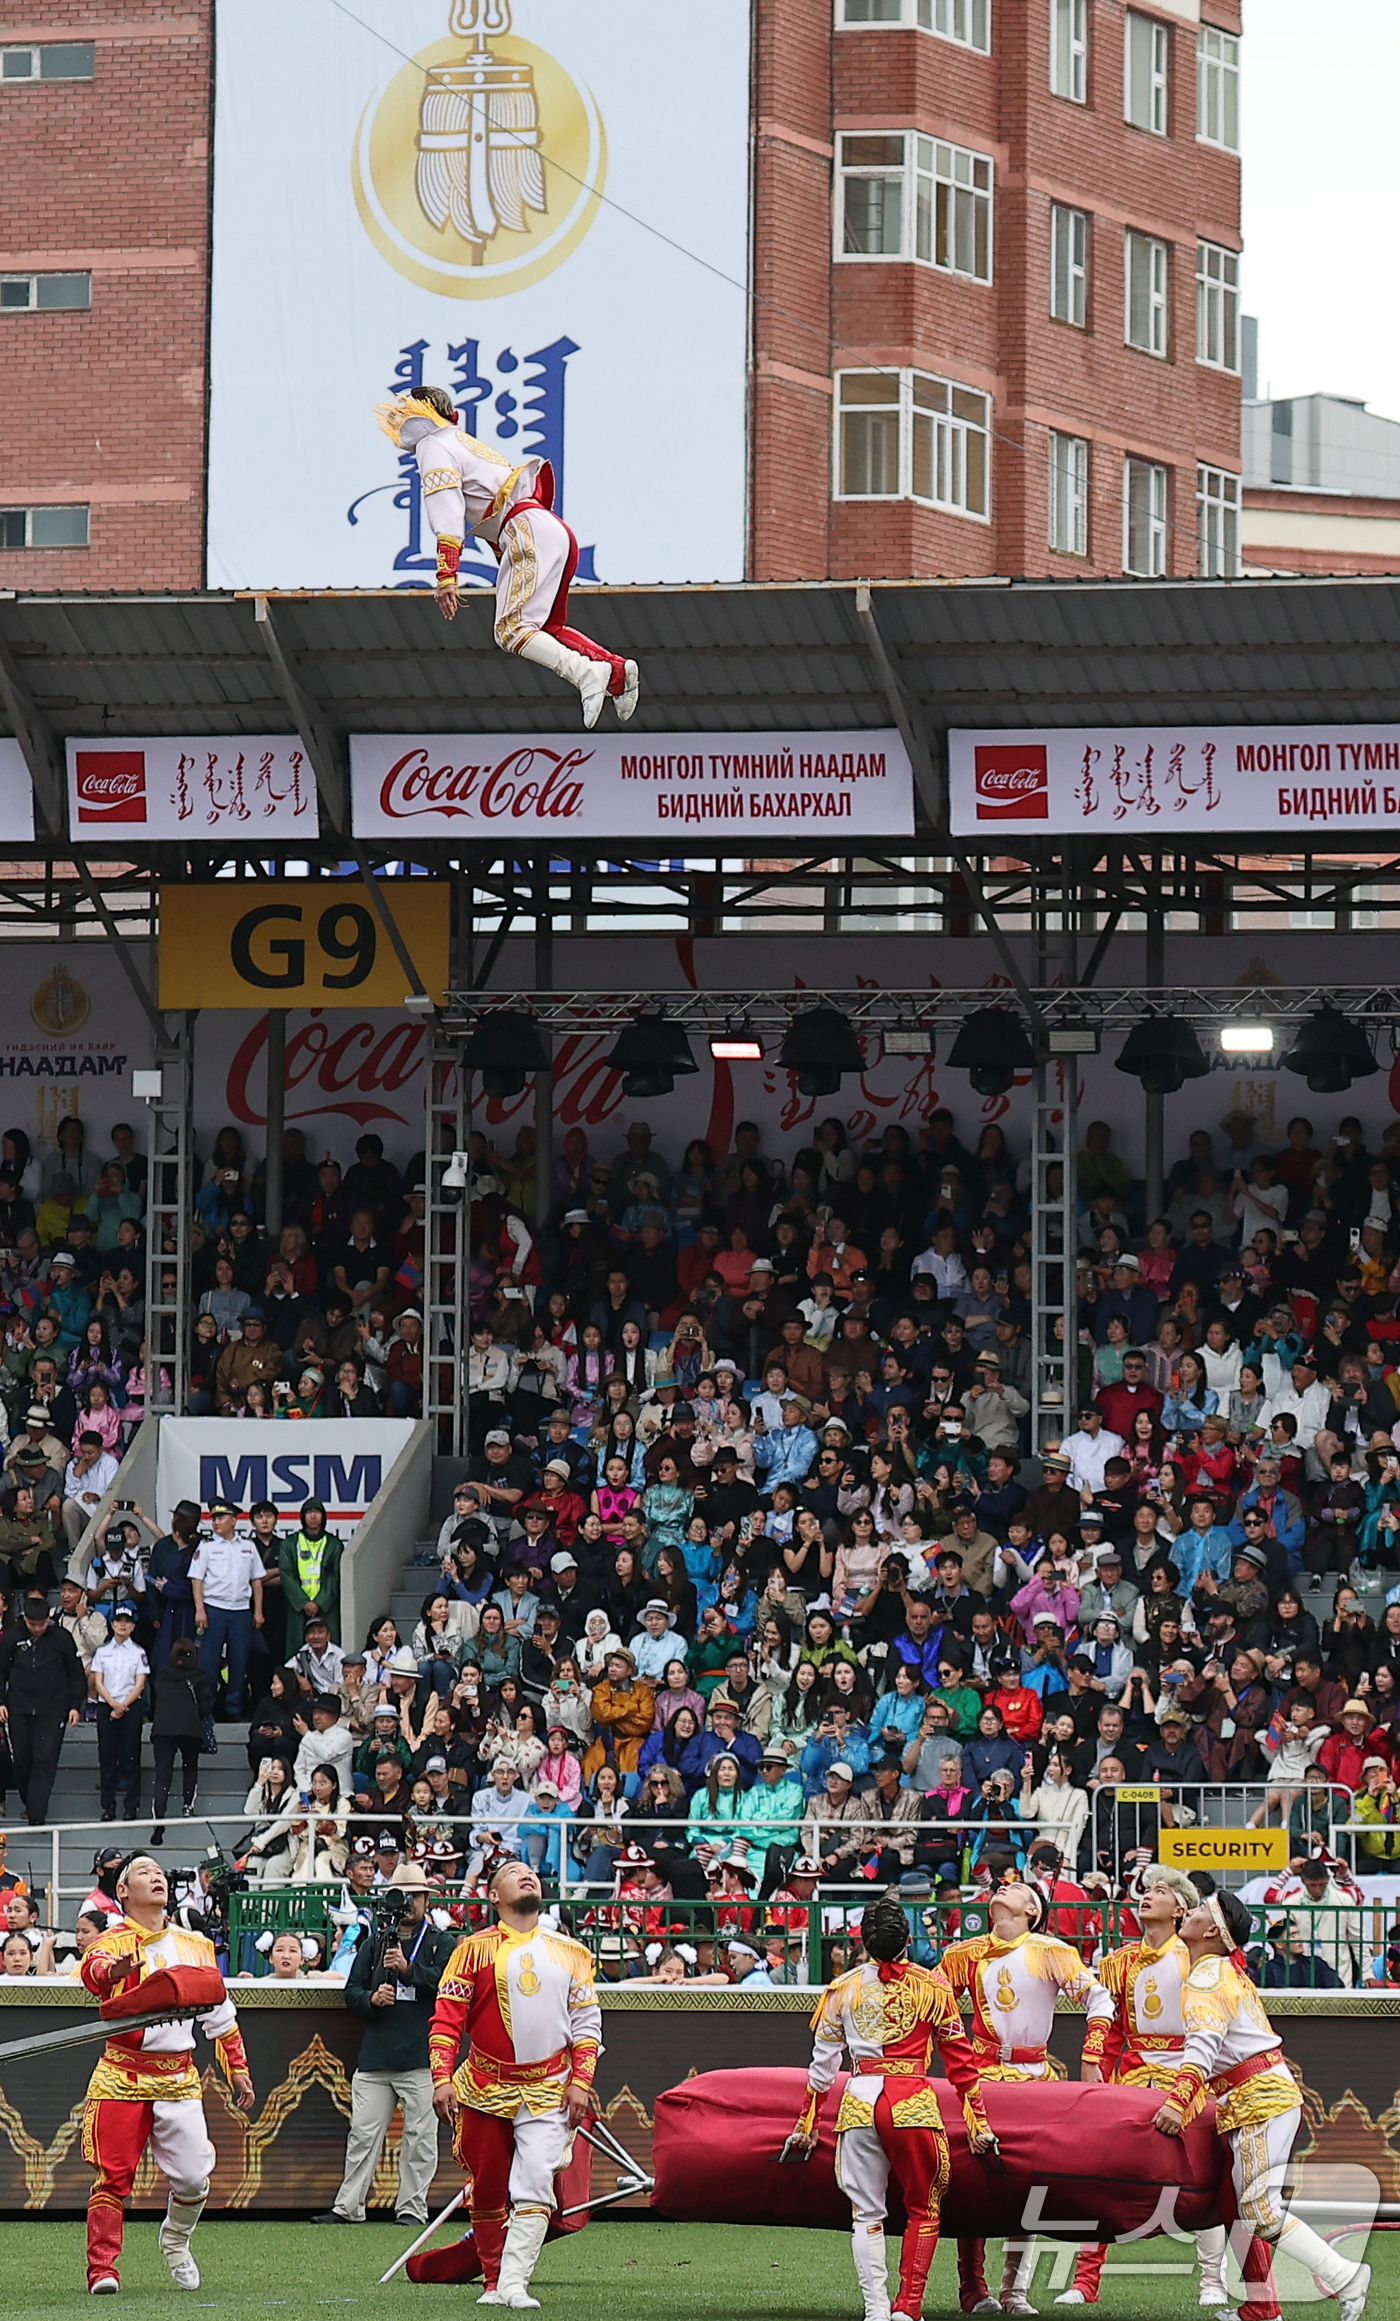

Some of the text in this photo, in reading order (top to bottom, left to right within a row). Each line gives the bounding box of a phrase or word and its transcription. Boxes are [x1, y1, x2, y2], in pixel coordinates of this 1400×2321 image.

[621, 747, 887, 783] МОНГОЛ ТҮМНИЙ НААДАМ
[1236, 744, 1331, 772] МОНГОЛ
[82, 773, 140, 795] Coca-Cola
[379, 747, 597, 820] Coca-Cola
[980, 768, 1041, 790] Coca-Cola
[657, 786, 852, 823] БИДНИЙ БАХАРХАЛ
[1278, 779, 1377, 820] БИДНИЙ
[230, 904, 378, 989] G9
[0, 1055, 127, 1077] НААДАМ
[200, 1455, 382, 1503] MSM
[1173, 1842, 1274, 1857] SECURITY
